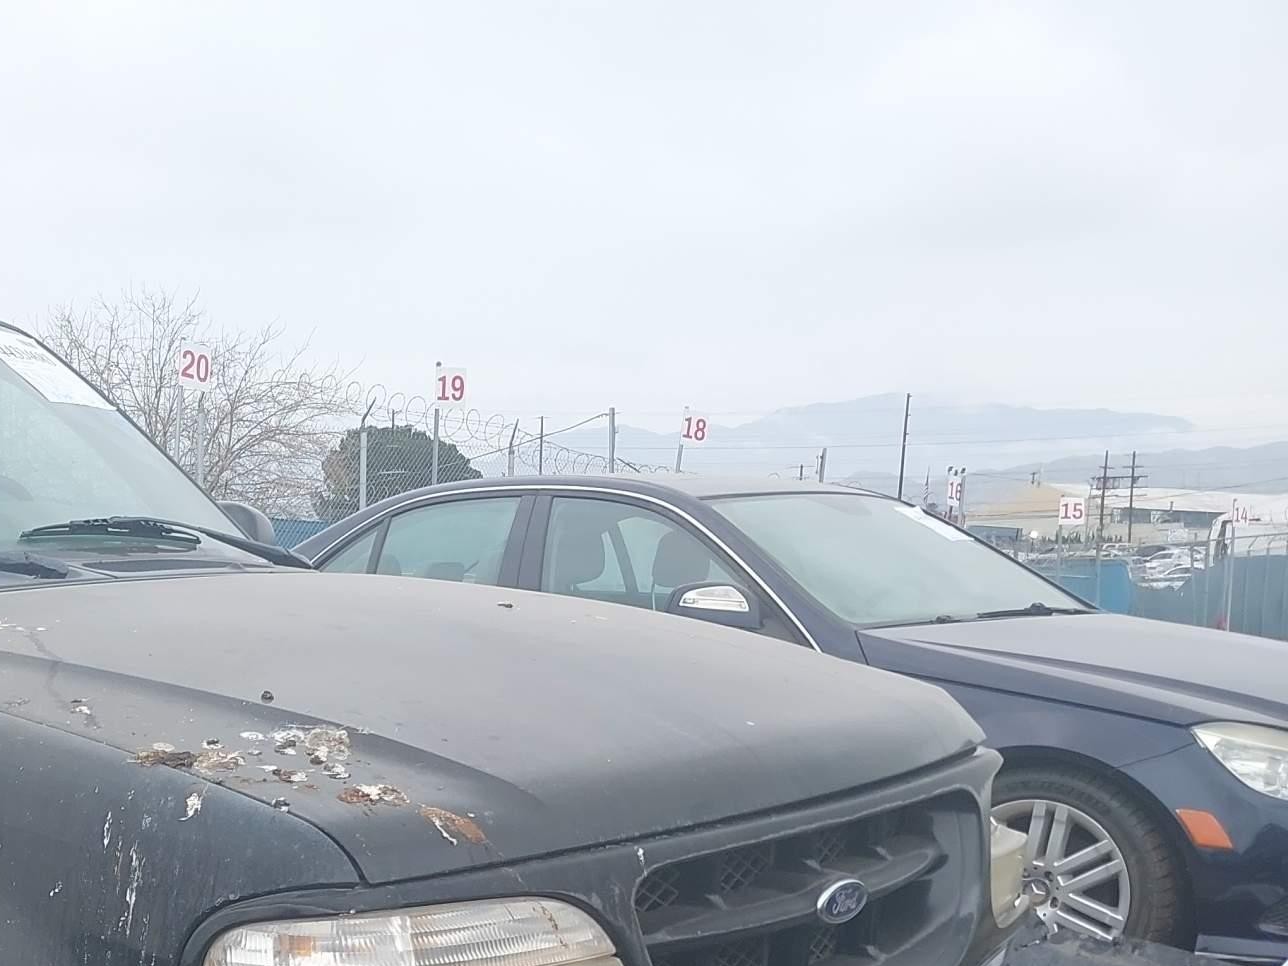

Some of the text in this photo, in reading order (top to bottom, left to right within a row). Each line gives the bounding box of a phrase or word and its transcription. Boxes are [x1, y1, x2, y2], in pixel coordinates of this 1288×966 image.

[180, 349, 211, 384] 20
[437, 374, 465, 402] 19
[682, 416, 707, 442] 18
[1060, 502, 1084, 520] 15
[1234, 506, 1248, 523] 14
[831, 888, 859, 915] Ford
